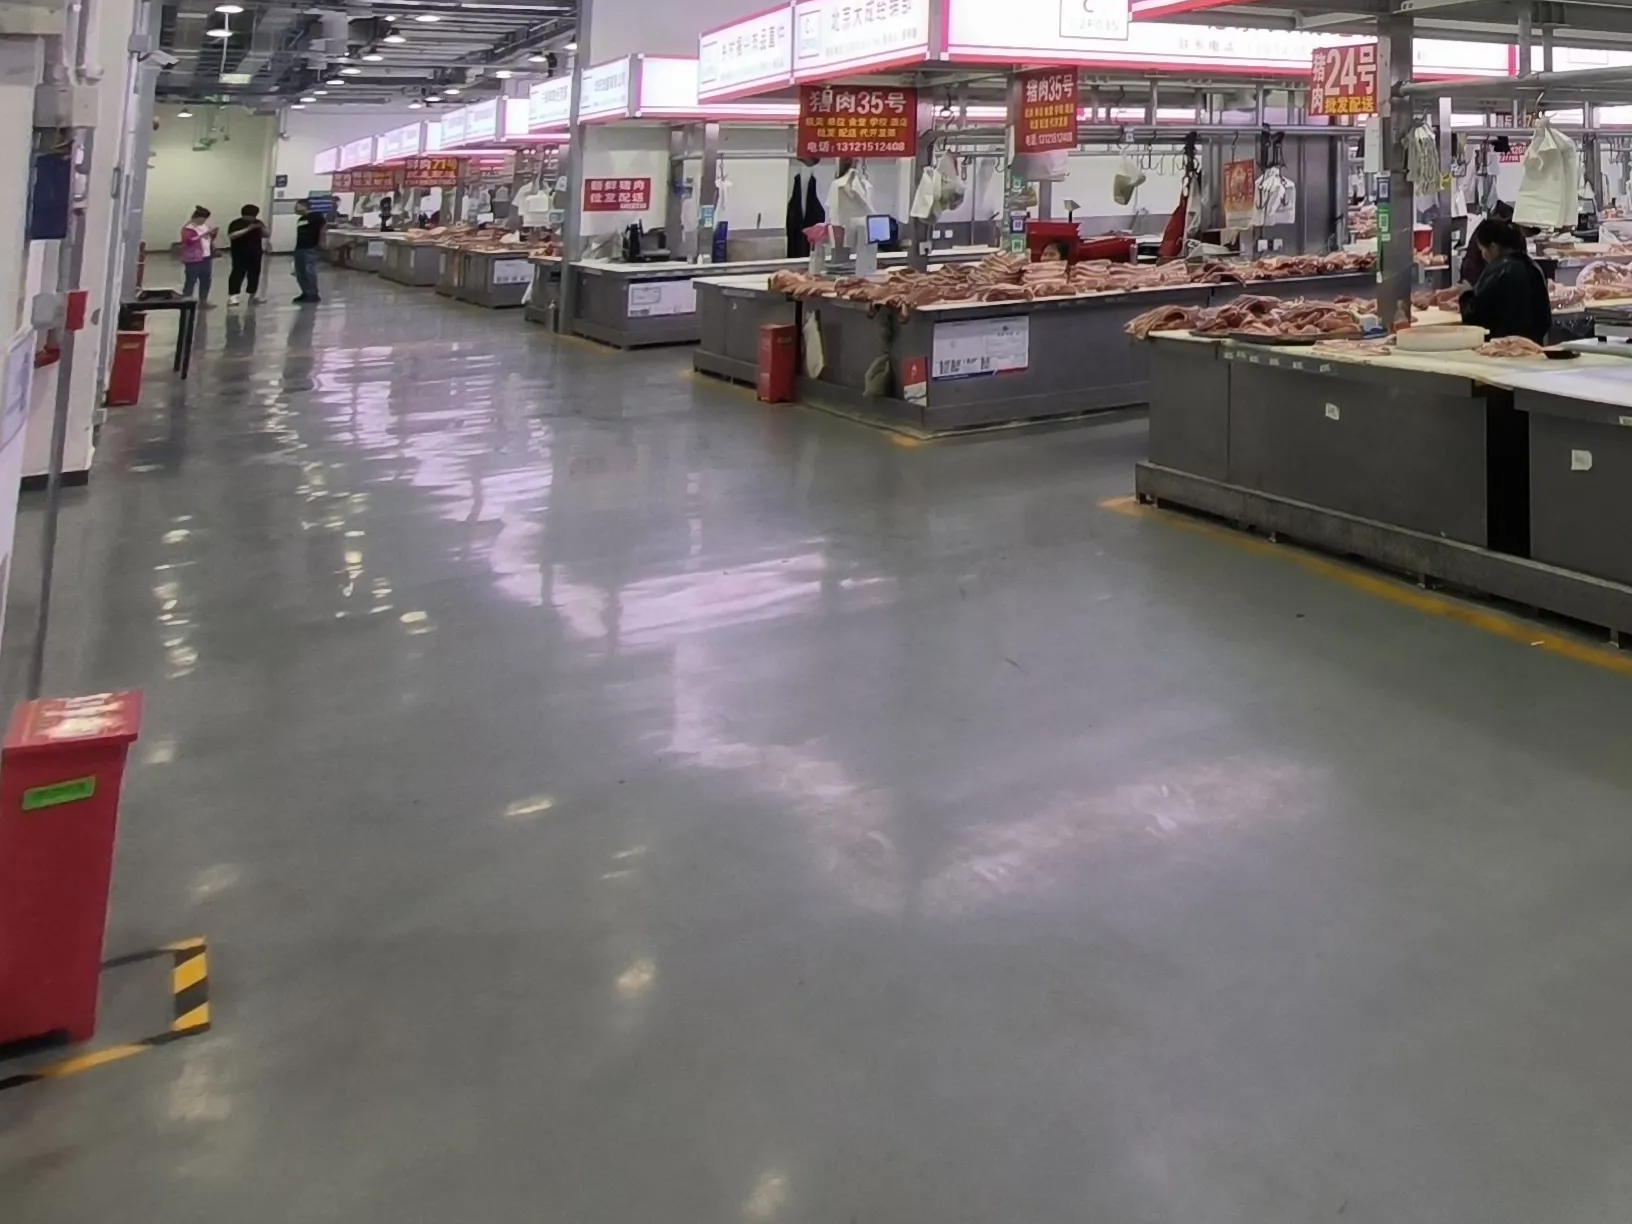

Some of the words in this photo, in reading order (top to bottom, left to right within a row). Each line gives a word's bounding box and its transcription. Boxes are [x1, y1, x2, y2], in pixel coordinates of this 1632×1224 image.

[1026, 74, 1074, 103] 猪肉35号
[1312, 52, 1326, 114] 猪肉
[1325, 46, 1376, 96] 24号
[810, 90, 906, 114] 猪肉35号
